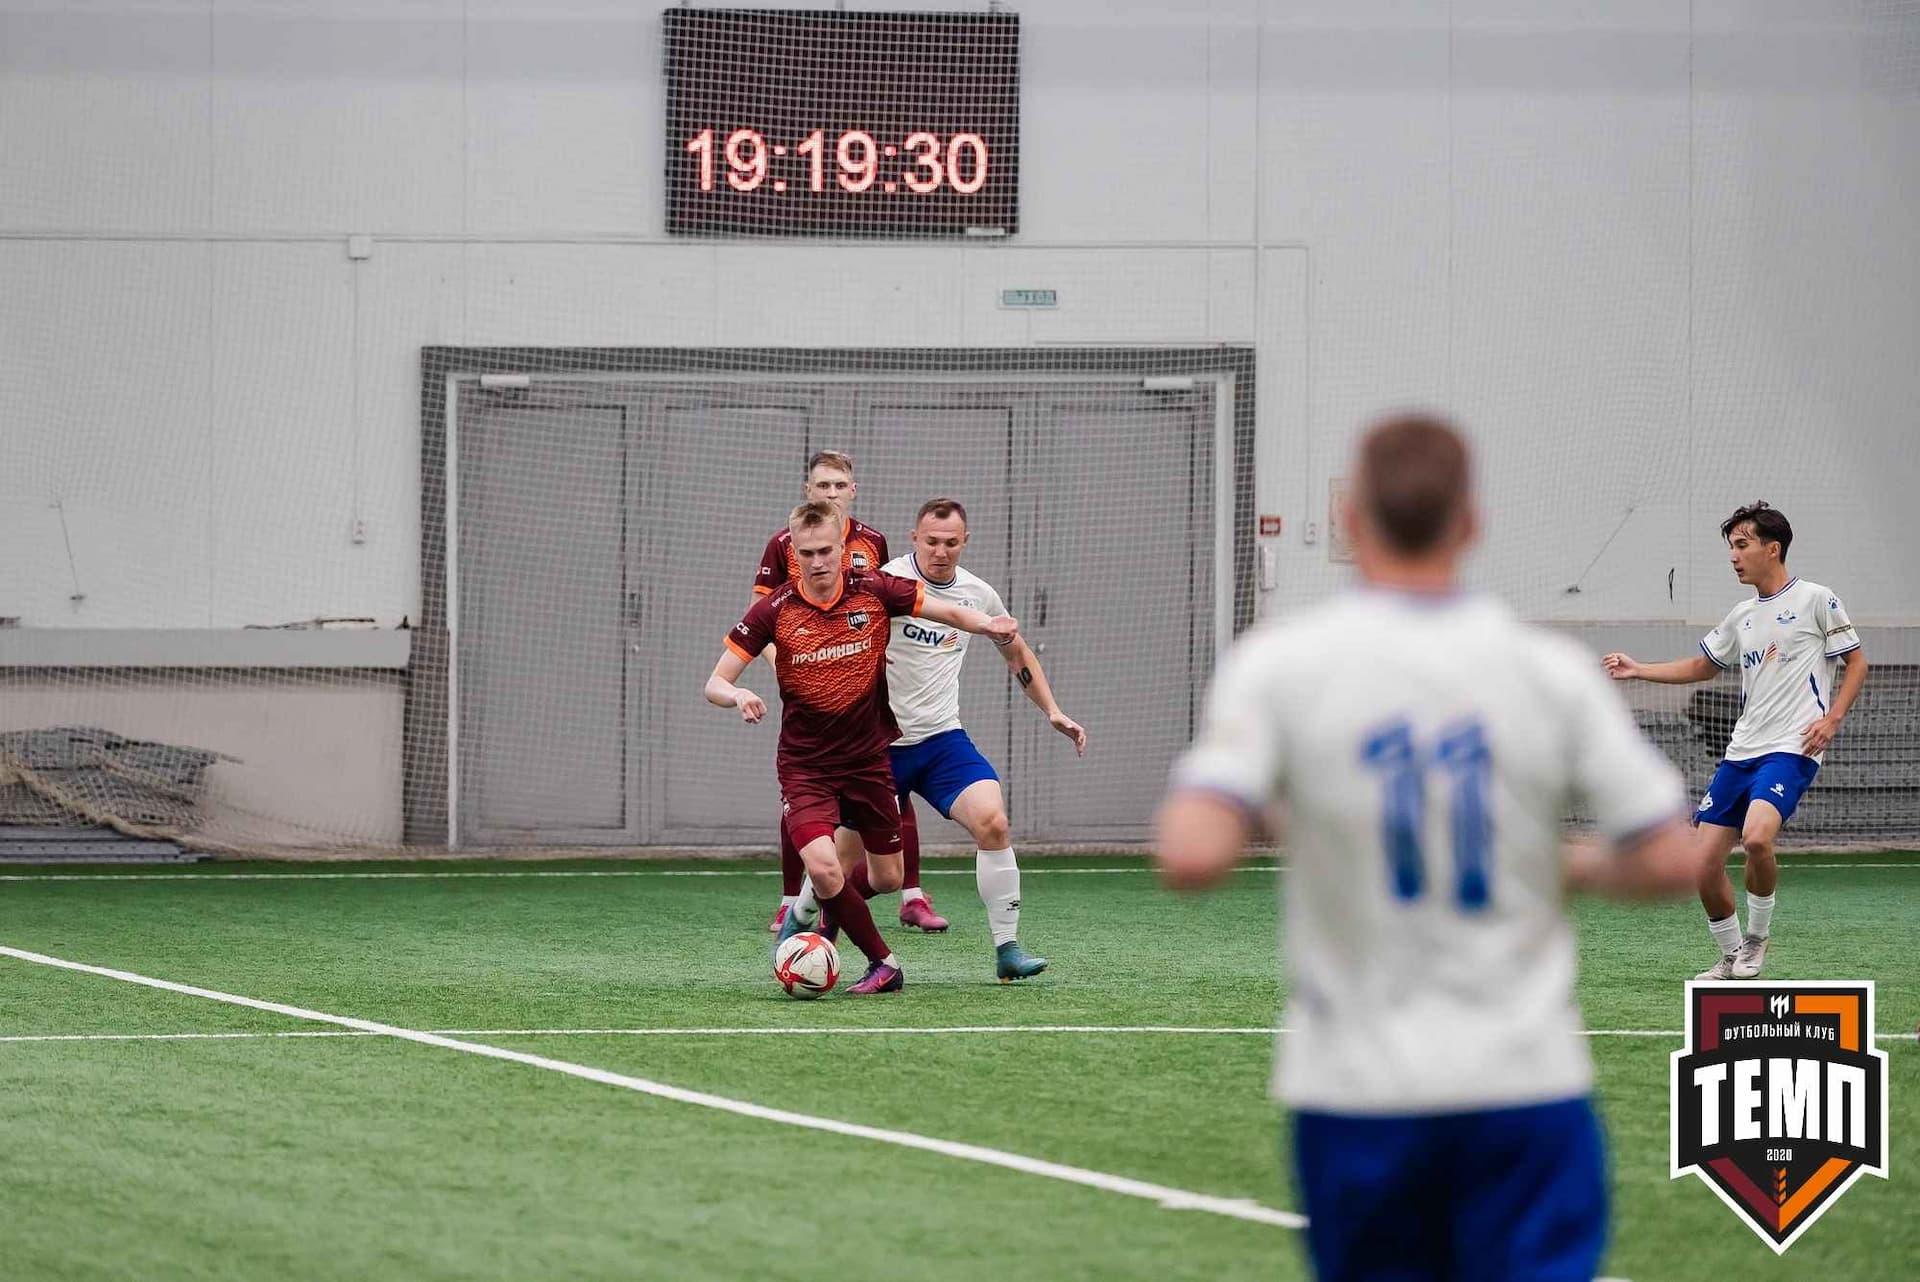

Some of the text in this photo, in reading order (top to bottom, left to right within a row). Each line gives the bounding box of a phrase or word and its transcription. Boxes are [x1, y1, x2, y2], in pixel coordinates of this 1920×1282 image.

[686, 128, 989, 194] 19:19:30
[903, 623, 945, 647] GNV
[1361, 718, 1494, 911] 11
